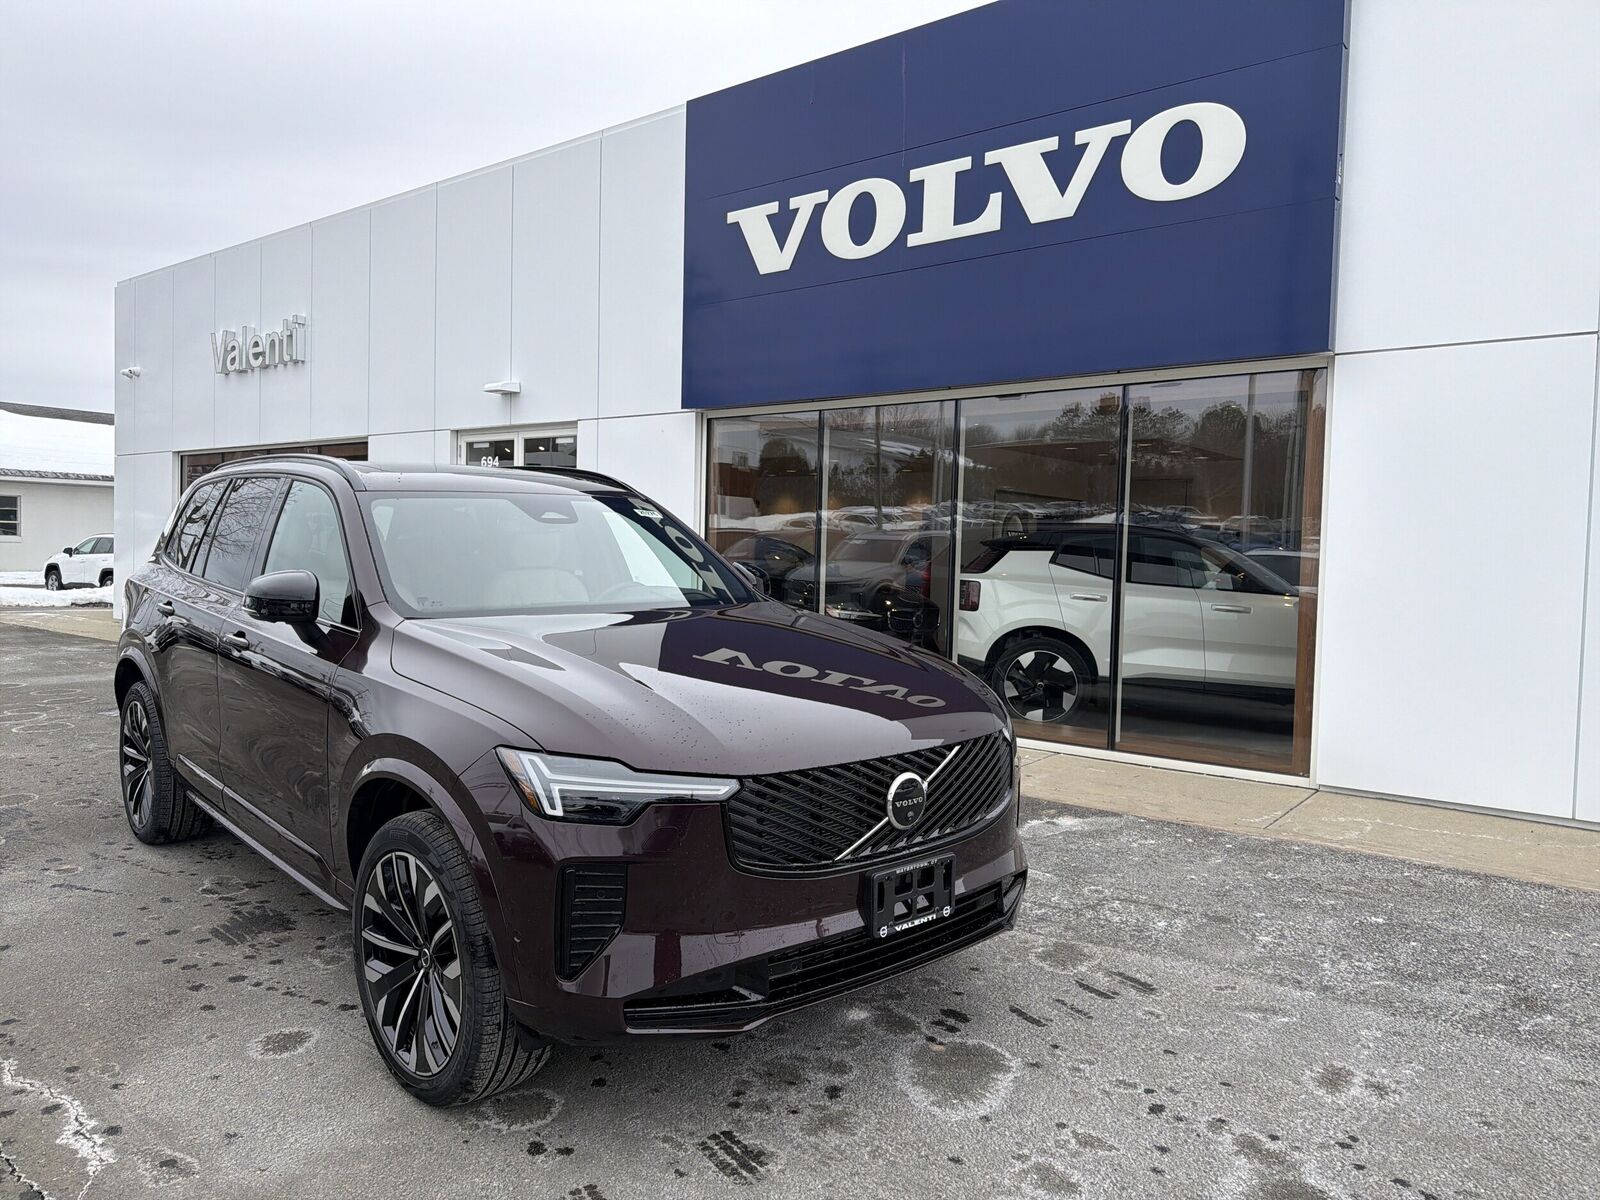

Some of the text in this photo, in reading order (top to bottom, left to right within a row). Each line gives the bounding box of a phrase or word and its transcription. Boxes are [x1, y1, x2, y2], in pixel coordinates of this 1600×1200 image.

[727, 102, 1246, 275] VOLVO
[211, 314, 305, 374] Valenti
[481, 456, 499, 467] 694
[895, 796, 923, 808] VOLVO
[895, 914, 936, 931] VALENTI
